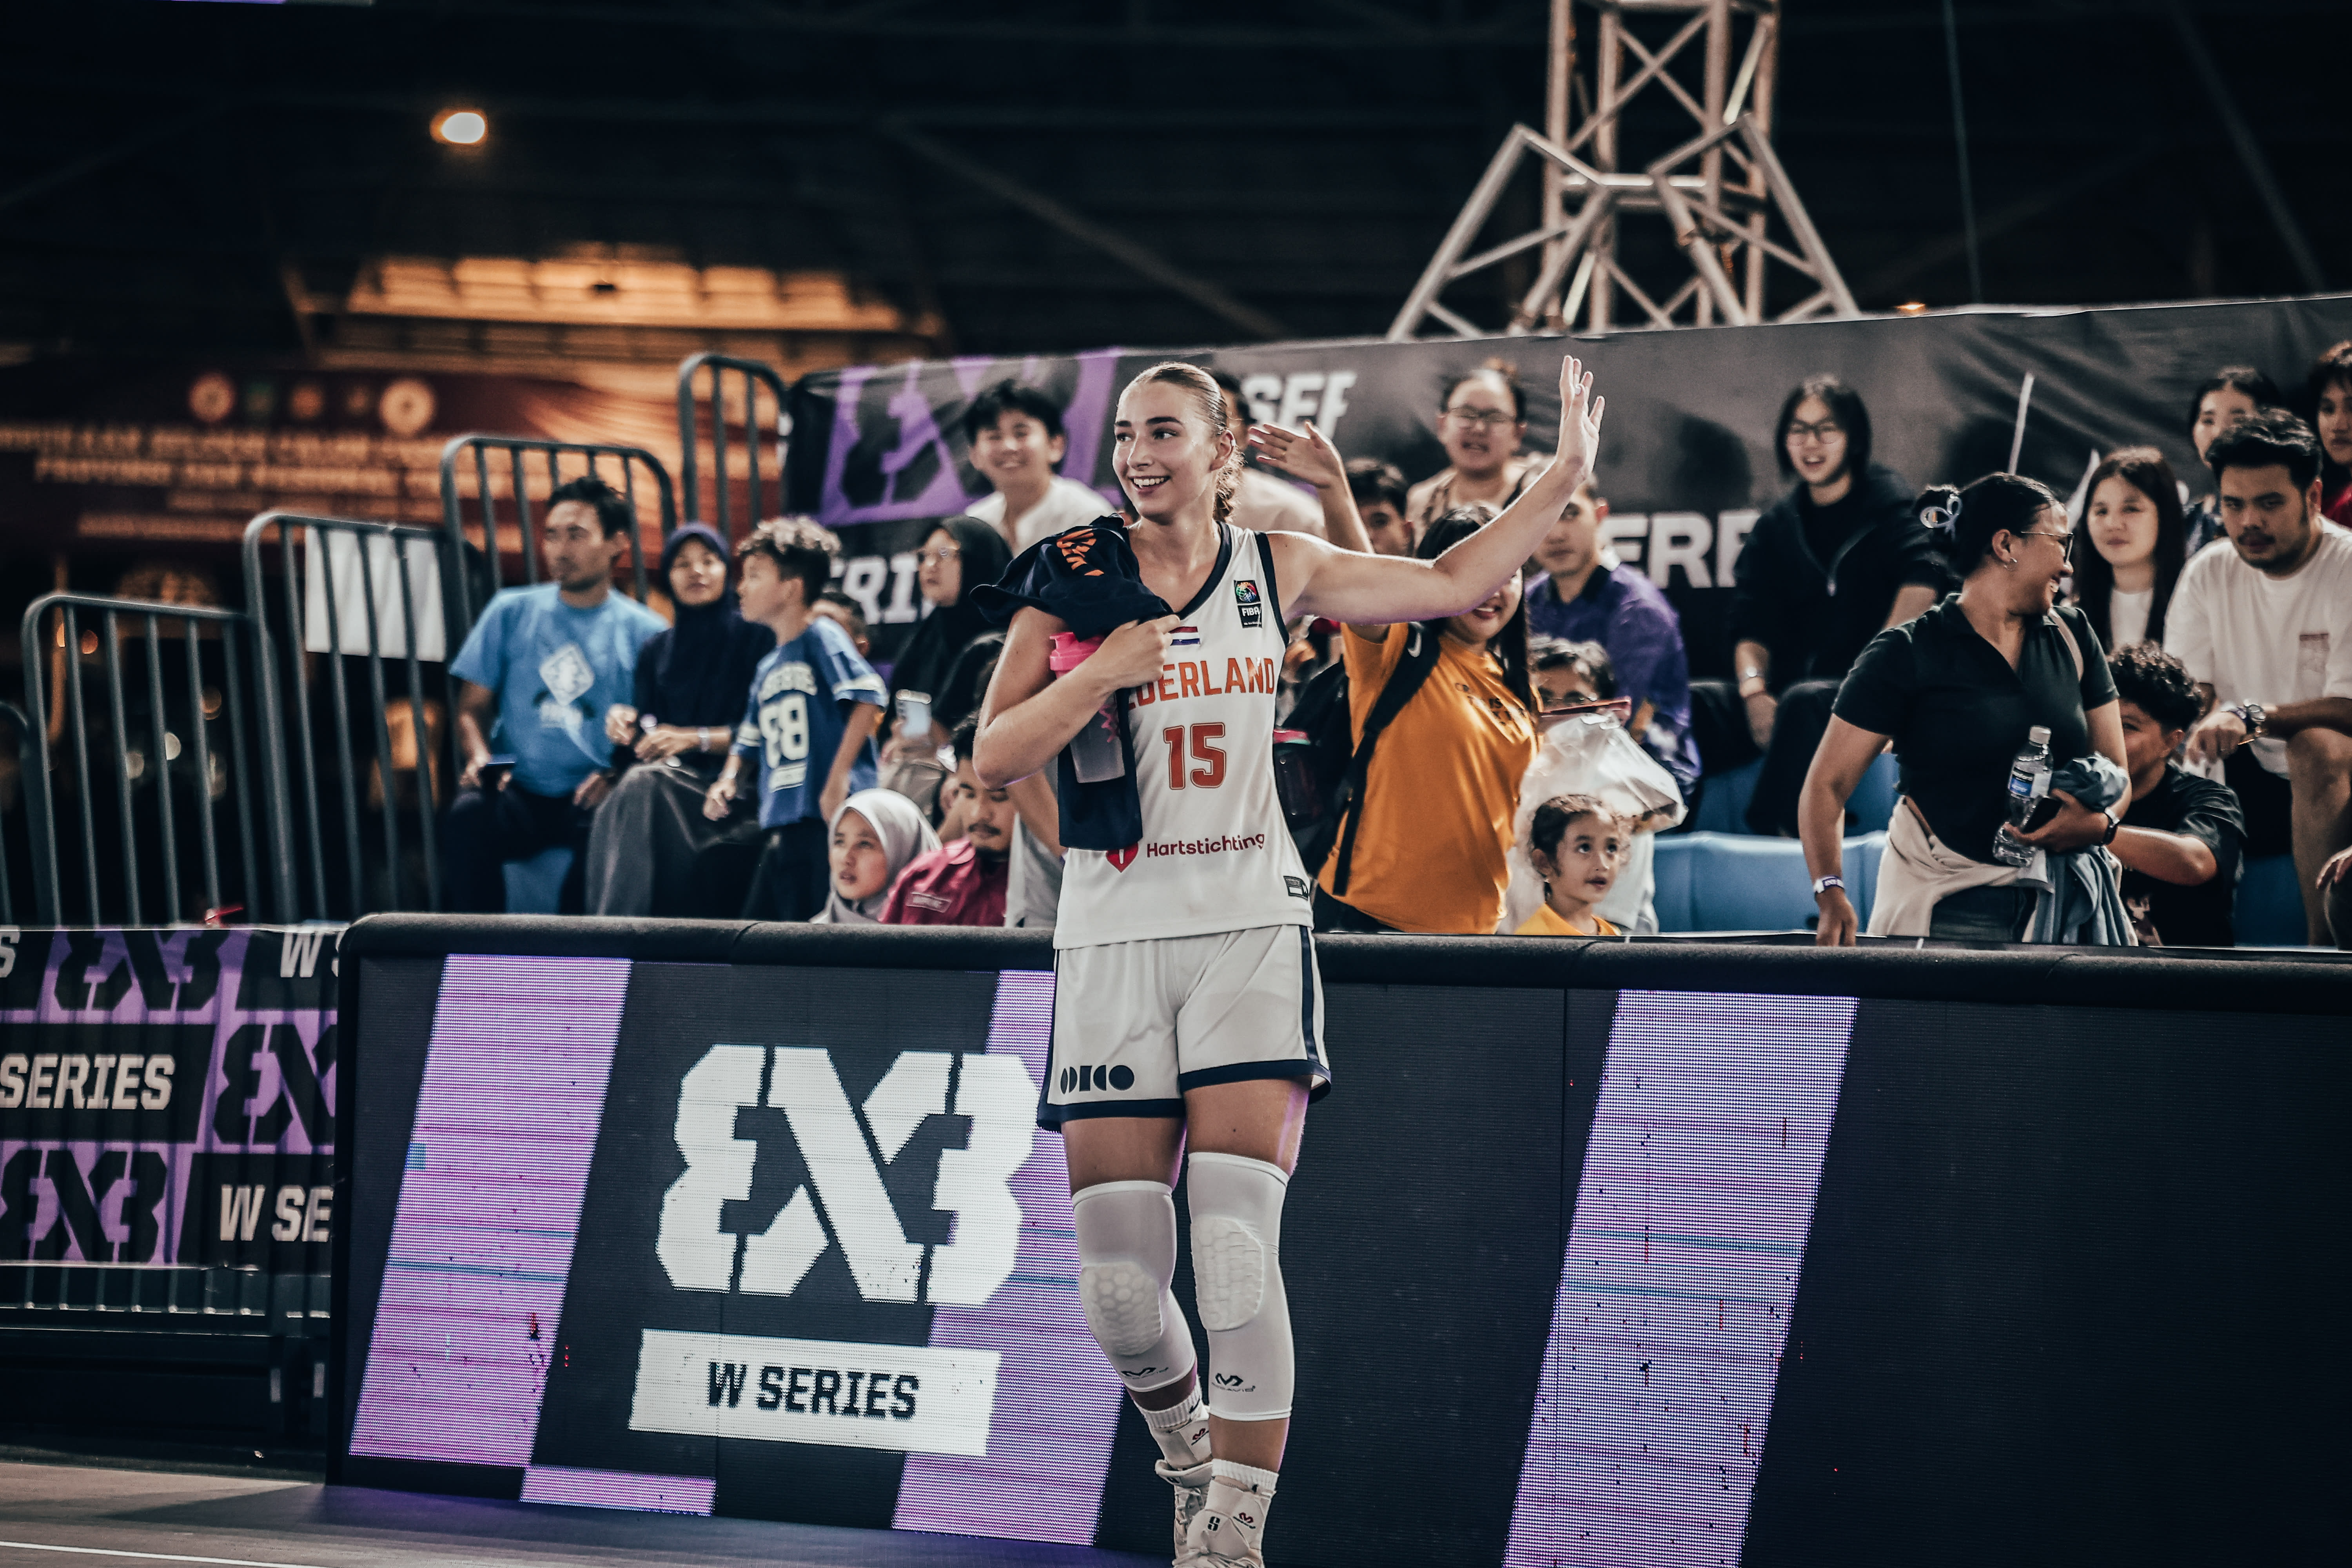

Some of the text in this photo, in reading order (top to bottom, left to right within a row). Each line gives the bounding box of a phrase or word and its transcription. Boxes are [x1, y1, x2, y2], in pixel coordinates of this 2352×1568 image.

[1241, 606, 1260, 617] FIBA
[1129, 657, 1275, 710] DERLAND
[1163, 722, 1226, 790] 15
[1147, 833, 1265, 858] Hartstichting
[0, 1054, 175, 1110] SERIES
[220, 1185, 265, 1241] W
[708, 1362, 920, 1419] W SERIES
